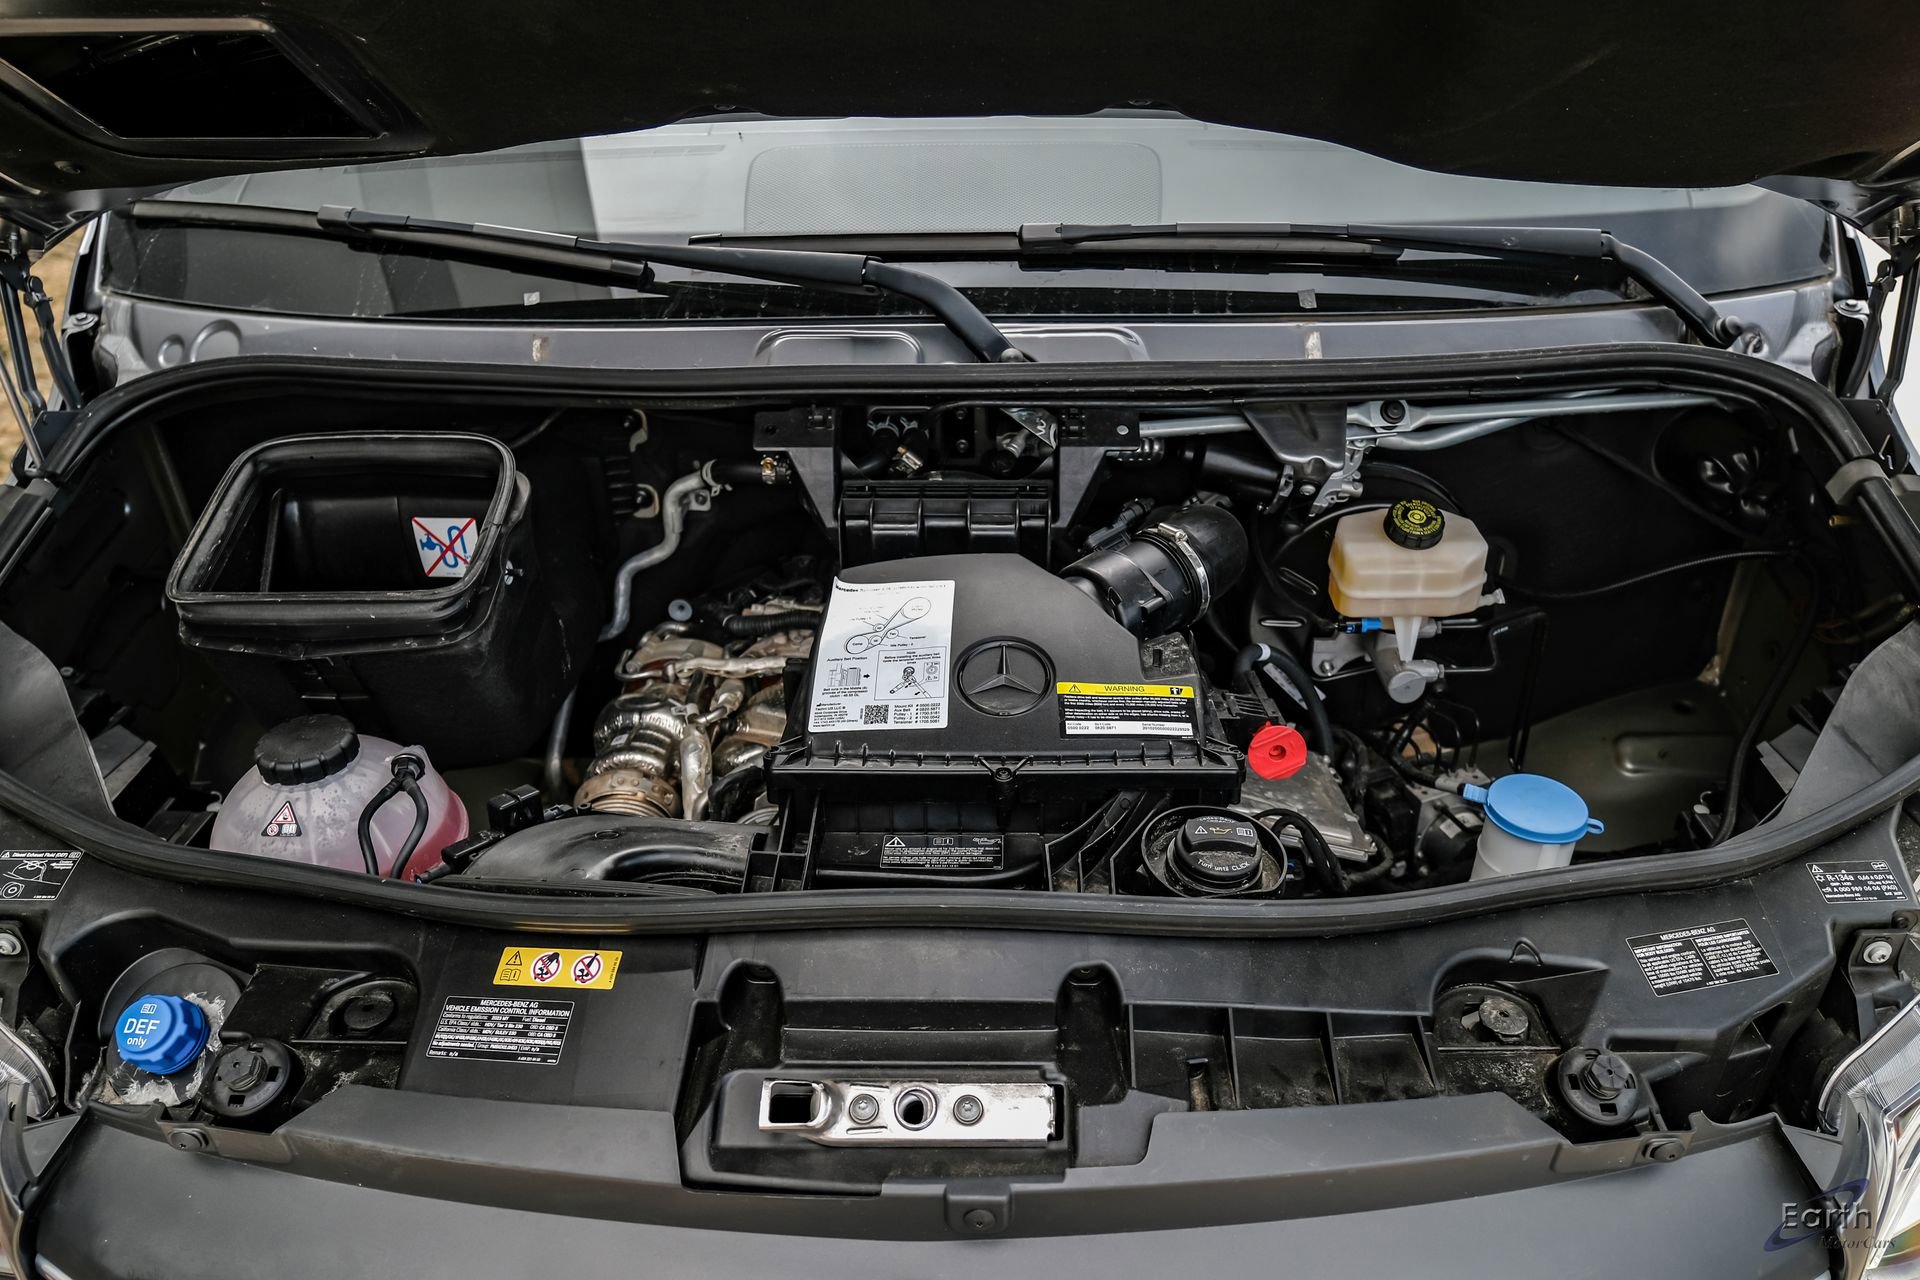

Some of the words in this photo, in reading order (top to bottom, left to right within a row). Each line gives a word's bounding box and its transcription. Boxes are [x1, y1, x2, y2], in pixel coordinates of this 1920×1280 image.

[1198, 860, 1212, 868] Turn
[1232, 861, 1250, 871] CLICK
[1660, 928, 1707, 941] MERCEDES-BENZ
[124, 1018, 160, 1035] DEF
[127, 1037, 147, 1048] only
